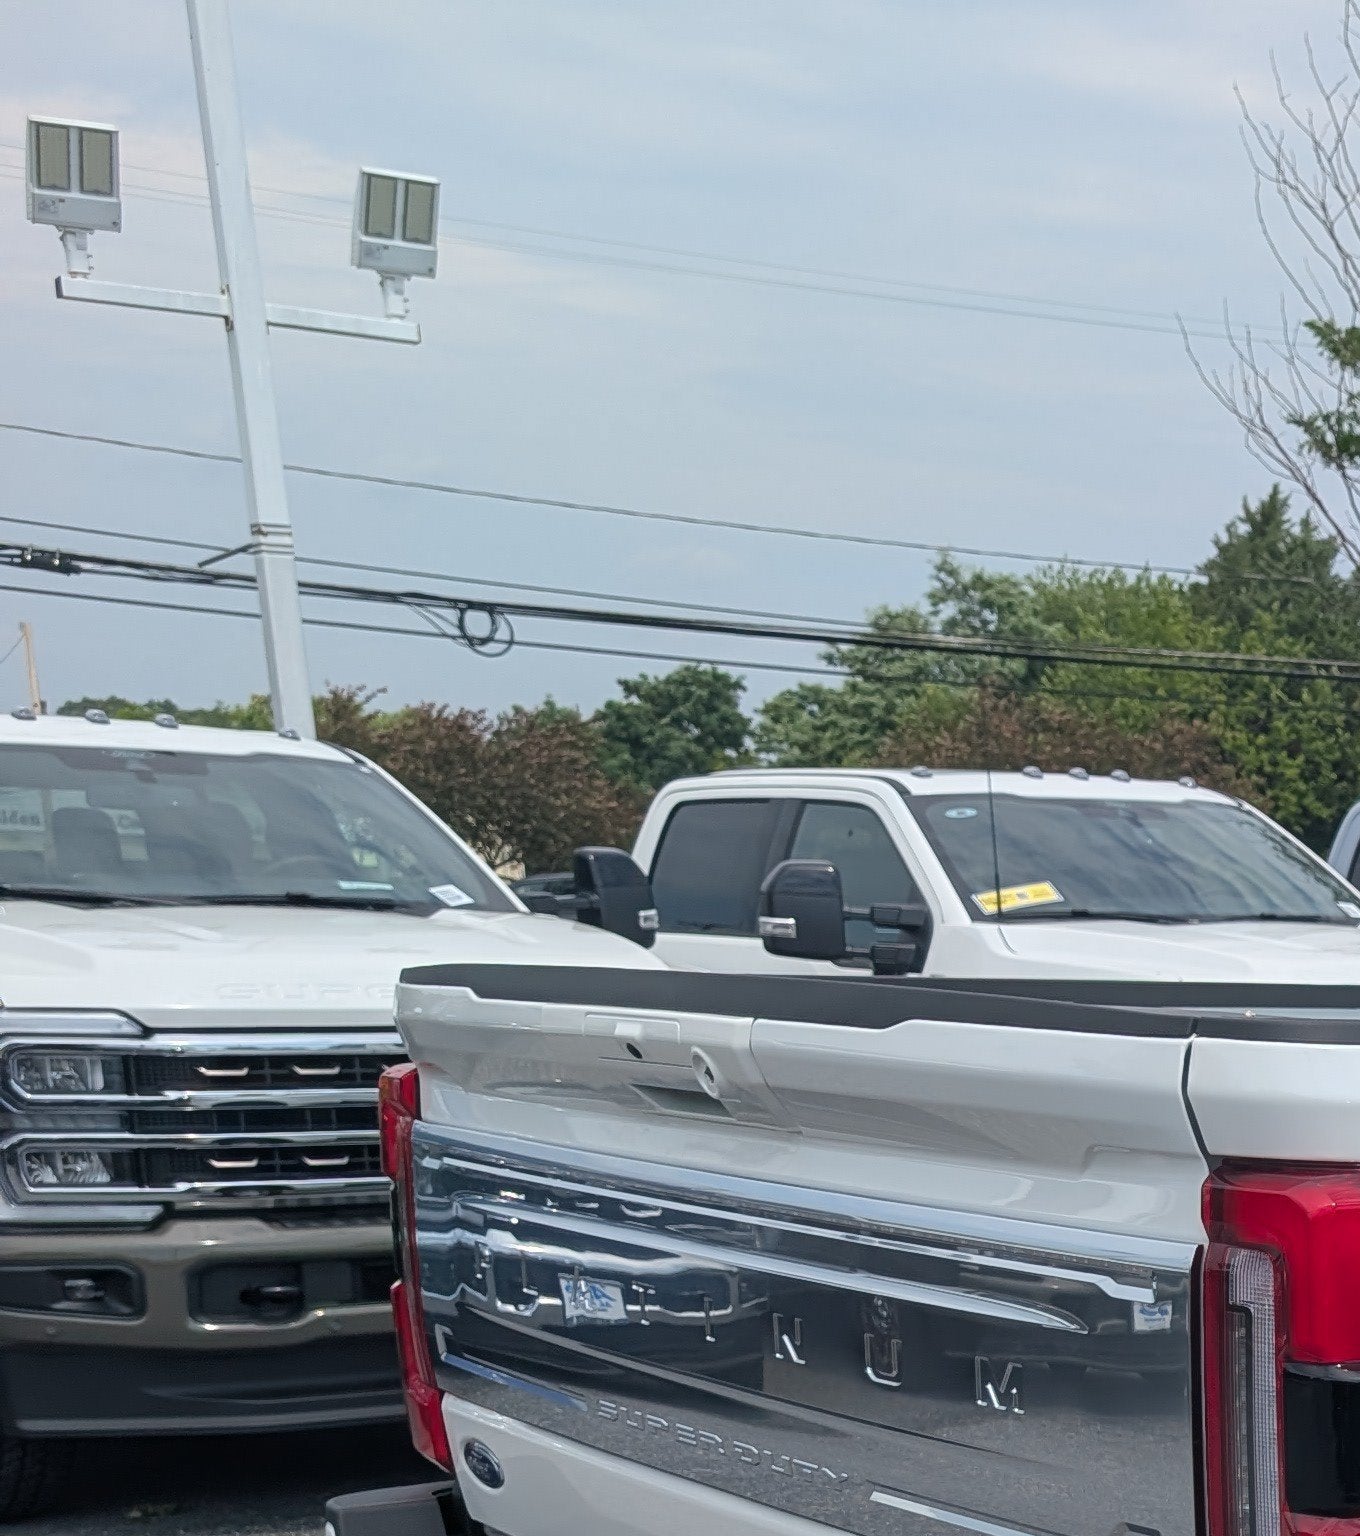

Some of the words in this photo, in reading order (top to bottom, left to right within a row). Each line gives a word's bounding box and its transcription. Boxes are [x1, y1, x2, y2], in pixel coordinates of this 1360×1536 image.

[475, 1240, 1027, 1415] PLATINUM
[597, 1399, 726, 1457] SUPER
[733, 1439, 849, 1492] DUTY
